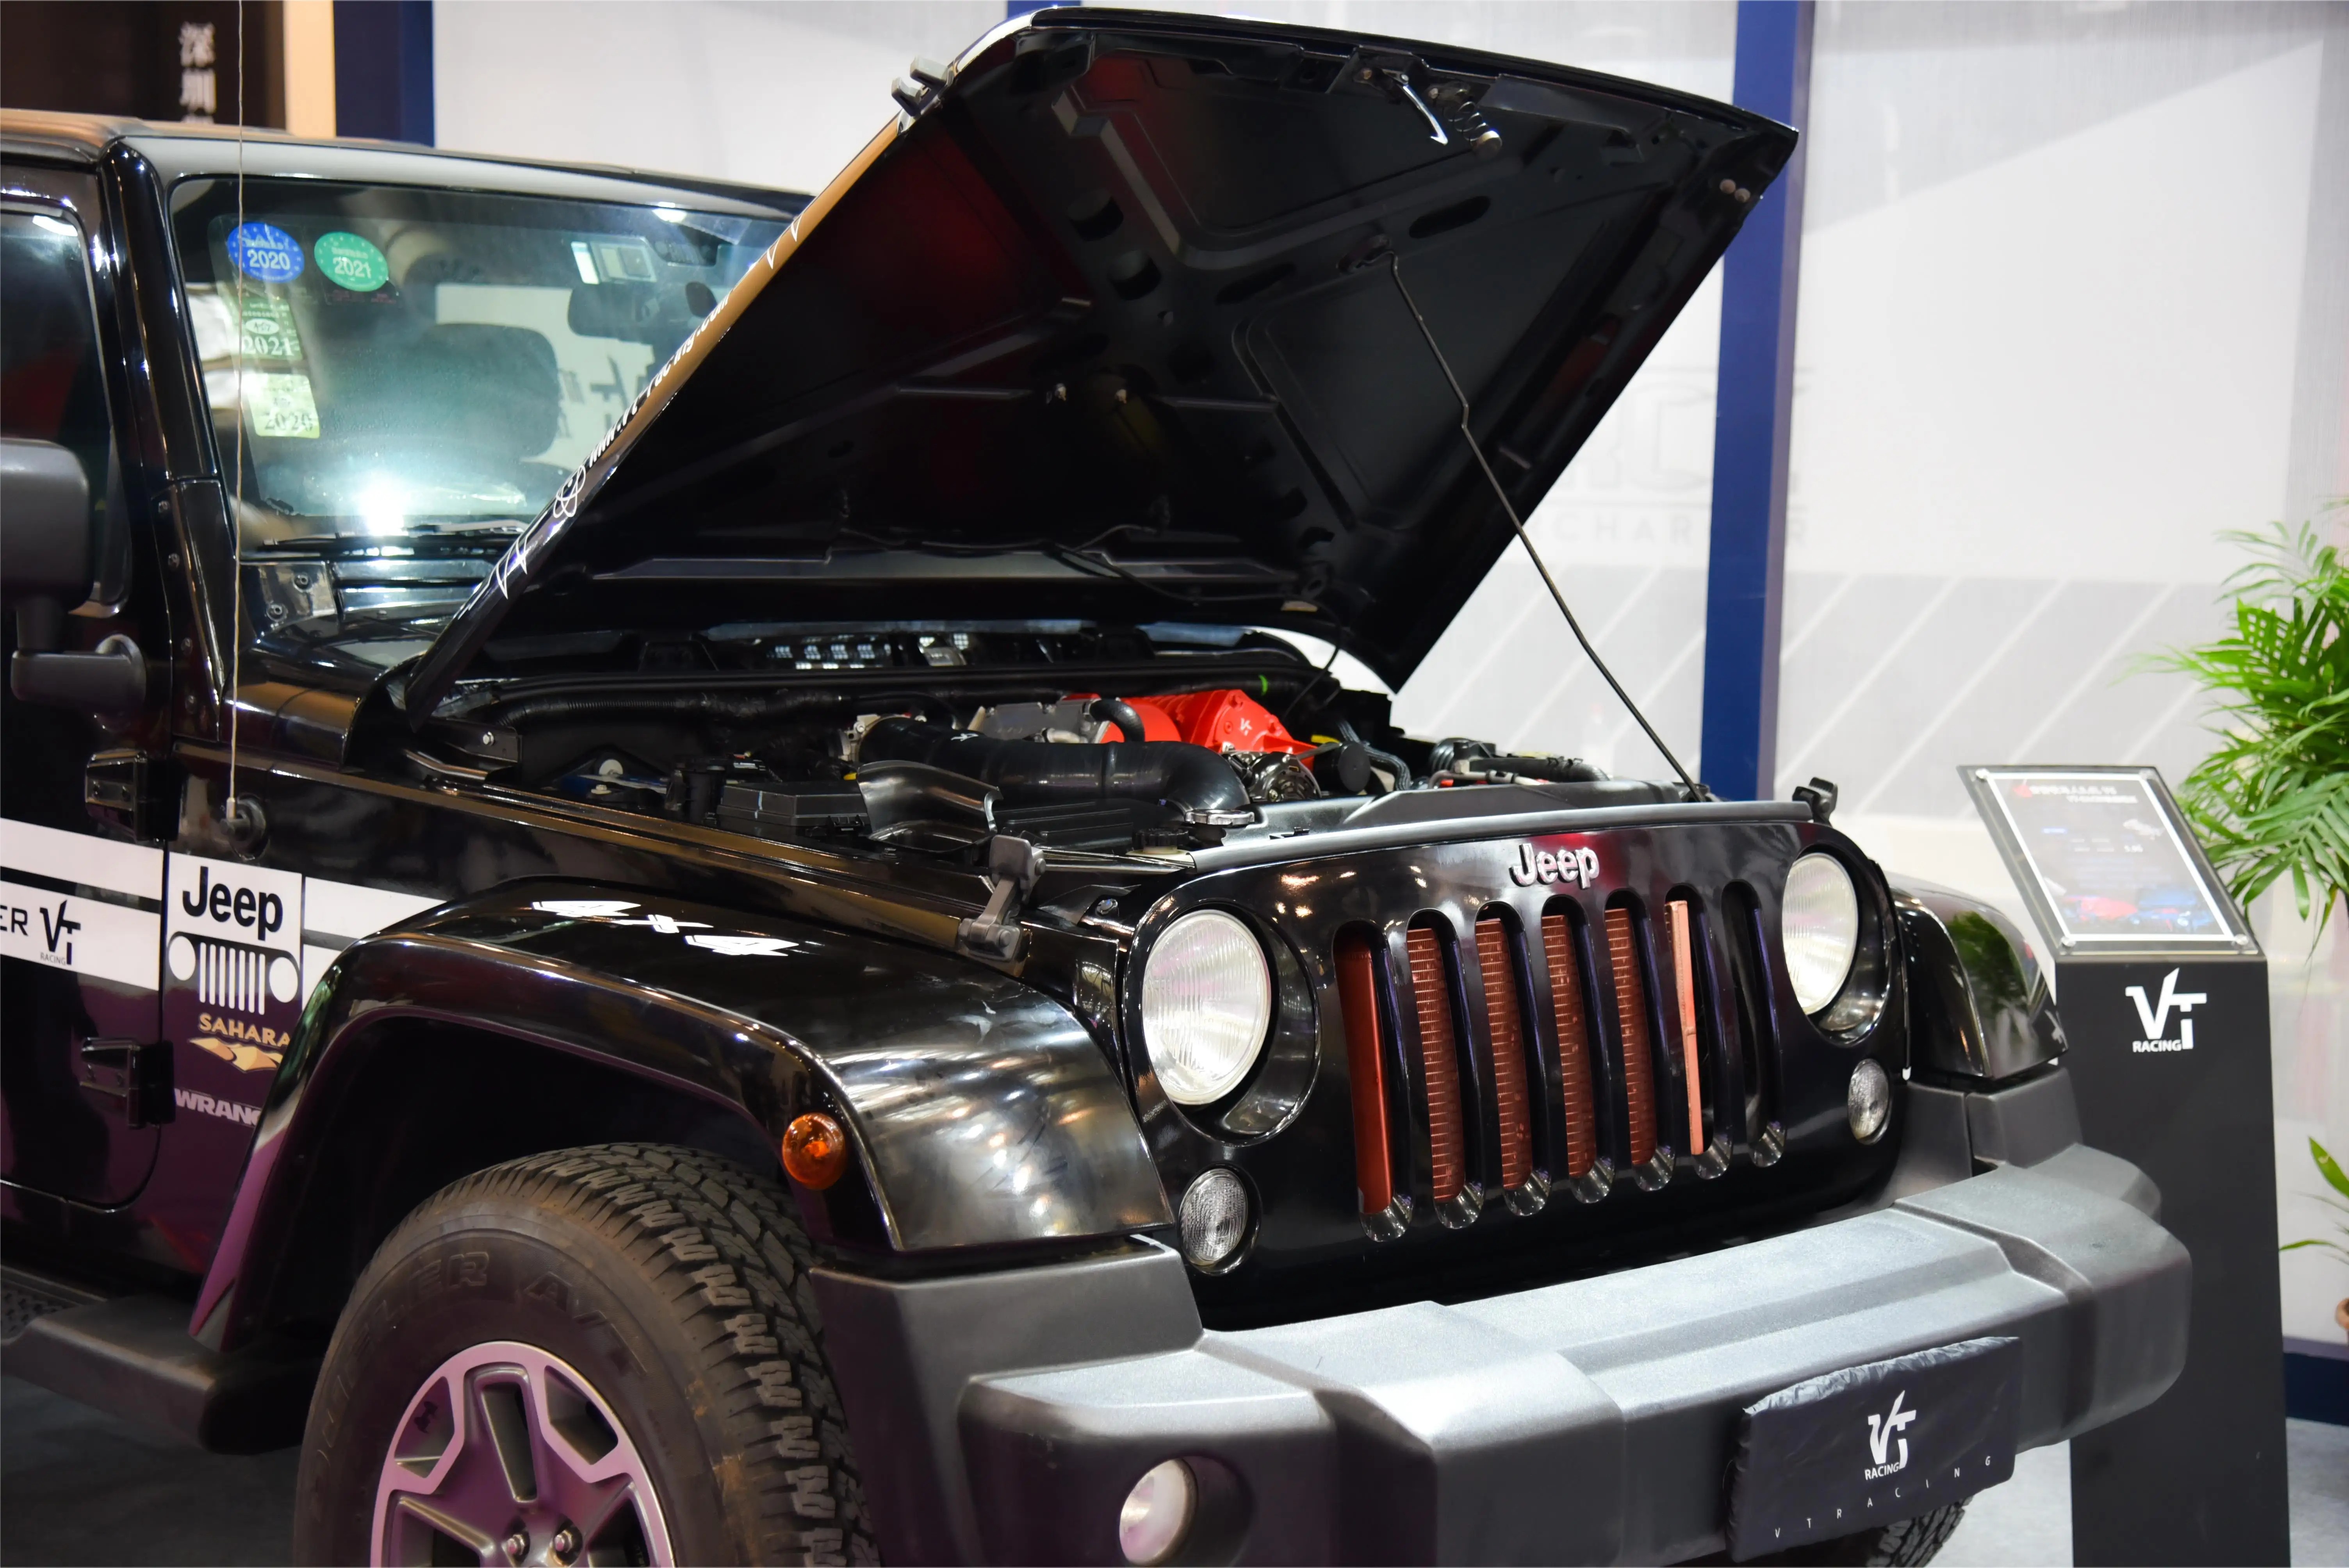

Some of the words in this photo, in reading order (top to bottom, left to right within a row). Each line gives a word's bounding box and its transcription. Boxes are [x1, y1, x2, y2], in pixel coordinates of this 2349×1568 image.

[247, 249, 291, 270] 2020
[332, 257, 371, 279] 2021
[242, 335, 294, 356] 2021
[1508, 843, 1600, 890] Jeep
[182, 866, 283, 941] Jeep
[40, 951, 66, 966] RACING
[198, 1013, 291, 1048] SAHARA
[2132, 1039, 2182, 1053] RACING
[1864, 1461, 1900, 1481] RACING
